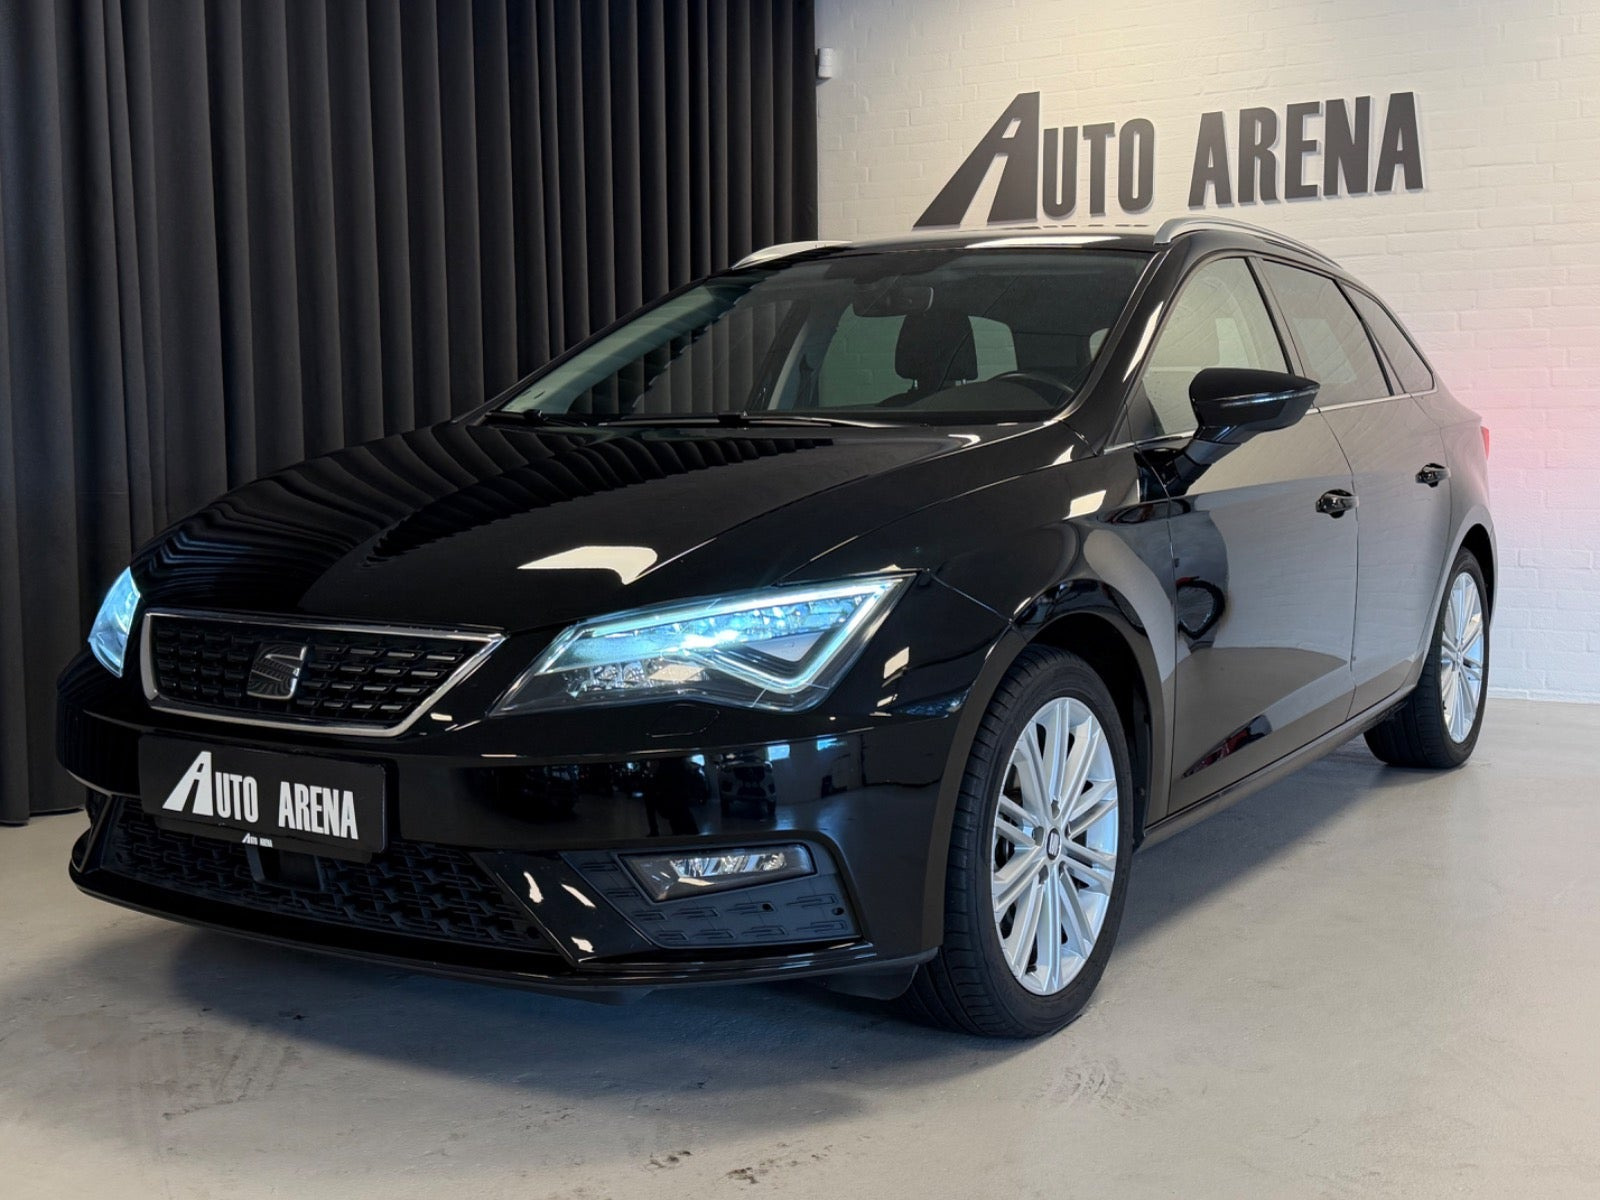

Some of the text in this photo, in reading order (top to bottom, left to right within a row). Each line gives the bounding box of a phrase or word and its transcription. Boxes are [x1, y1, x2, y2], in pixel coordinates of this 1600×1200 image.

[913, 91, 1424, 228] AUTO ARENA
[162, 751, 359, 840] AUTO ARENA
